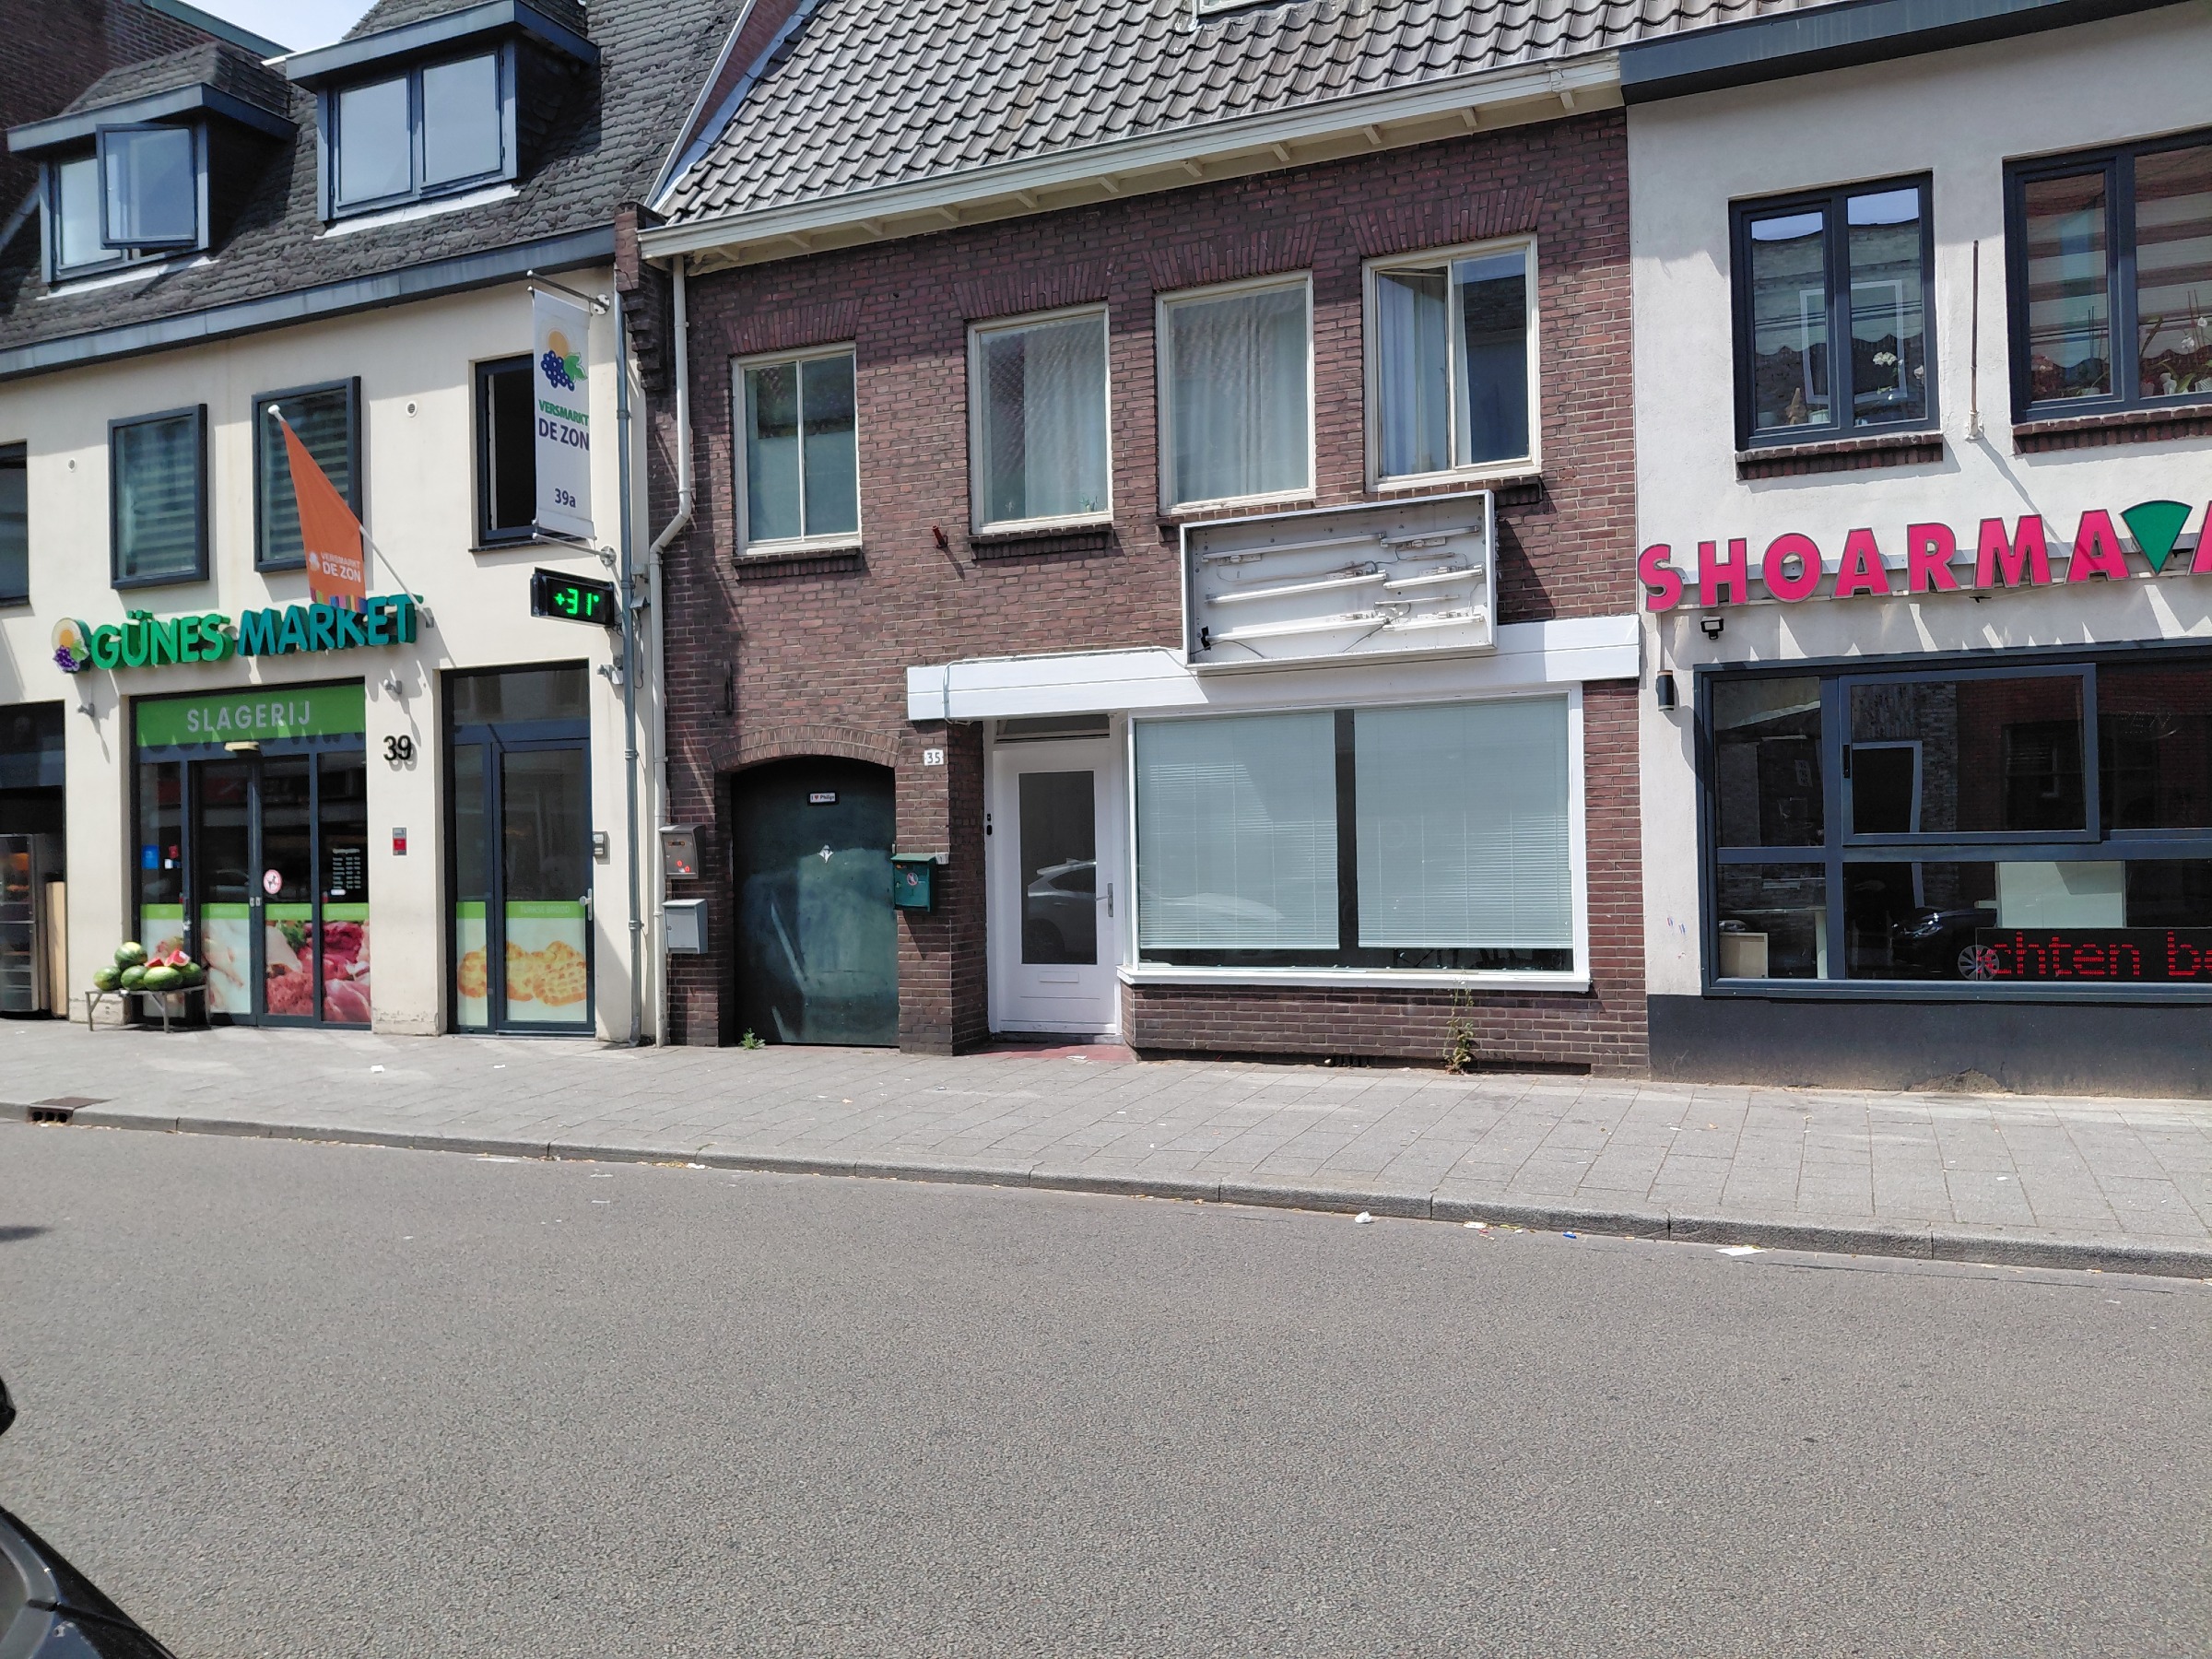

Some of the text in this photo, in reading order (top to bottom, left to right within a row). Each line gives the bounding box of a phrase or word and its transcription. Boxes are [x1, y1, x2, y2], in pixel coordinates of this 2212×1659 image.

[538, 399, 590, 426] VERSMARKT
[538, 418, 590, 452] DE ZON
[554, 488, 576, 508] 39a
[323, 560, 361, 583] DE ZON
[1637, 508, 2131, 613] SHOARMA
[91, 594, 420, 670] GÜNES MARKET
[186, 700, 311, 733] SLAGERIJ
[382, 735, 412, 761] 39
[926, 751, 941, 764] 35
[1977, 931, 2141, 977] chten
